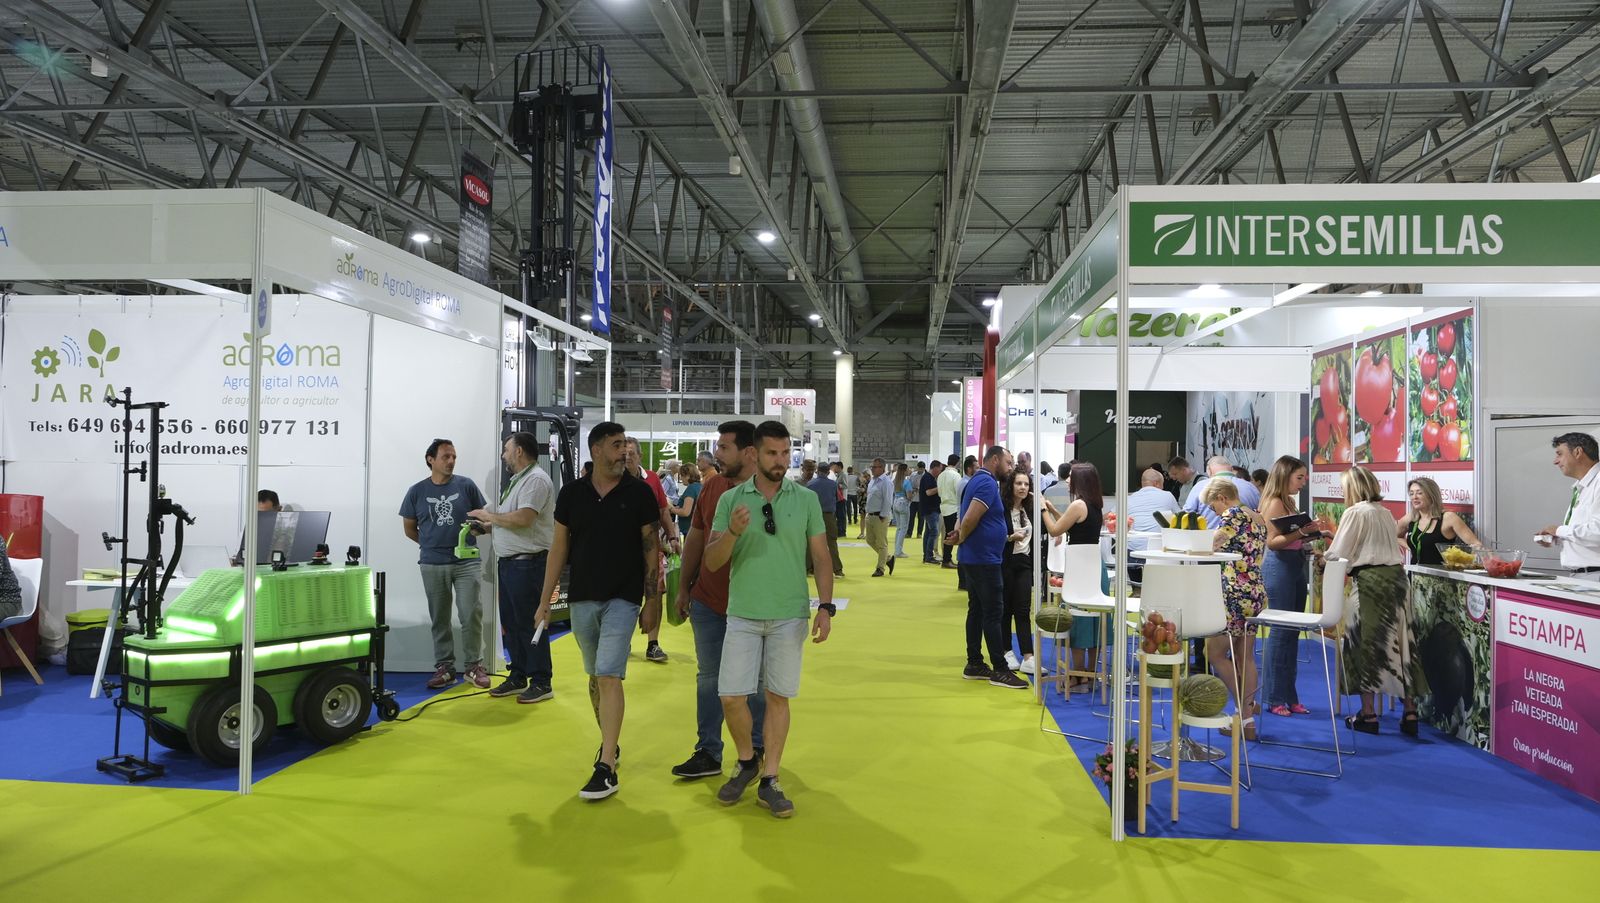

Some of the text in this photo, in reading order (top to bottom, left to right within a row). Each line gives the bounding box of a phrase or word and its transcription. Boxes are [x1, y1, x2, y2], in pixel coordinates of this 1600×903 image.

[1206, 214, 1504, 256] INTERSEMILLAS
[382, 271, 434, 305] AgroDigital
[435, 291, 462, 315] ROMA
[32, 383, 117, 404] JARA
[223, 375, 339, 390] Agroigital ROMA
[222, 395, 233, 405] de
[292, 394, 340, 408] agricultor
[28, 420, 63, 433] Tels:
[68, 417, 104, 433] 649
[215, 419, 248, 435] 660
[259, 420, 297, 435] 977
[306, 420, 340, 436] 131
[1509, 612, 1587, 653] ESTAMPA
[1523, 668, 1565, 692] LA NEGRA
[1525, 686, 1563, 710] VETEADA
[1511, 700, 1578, 734] ¡TAN ESPERADA!
[1513, 737, 1532, 756] Gran
